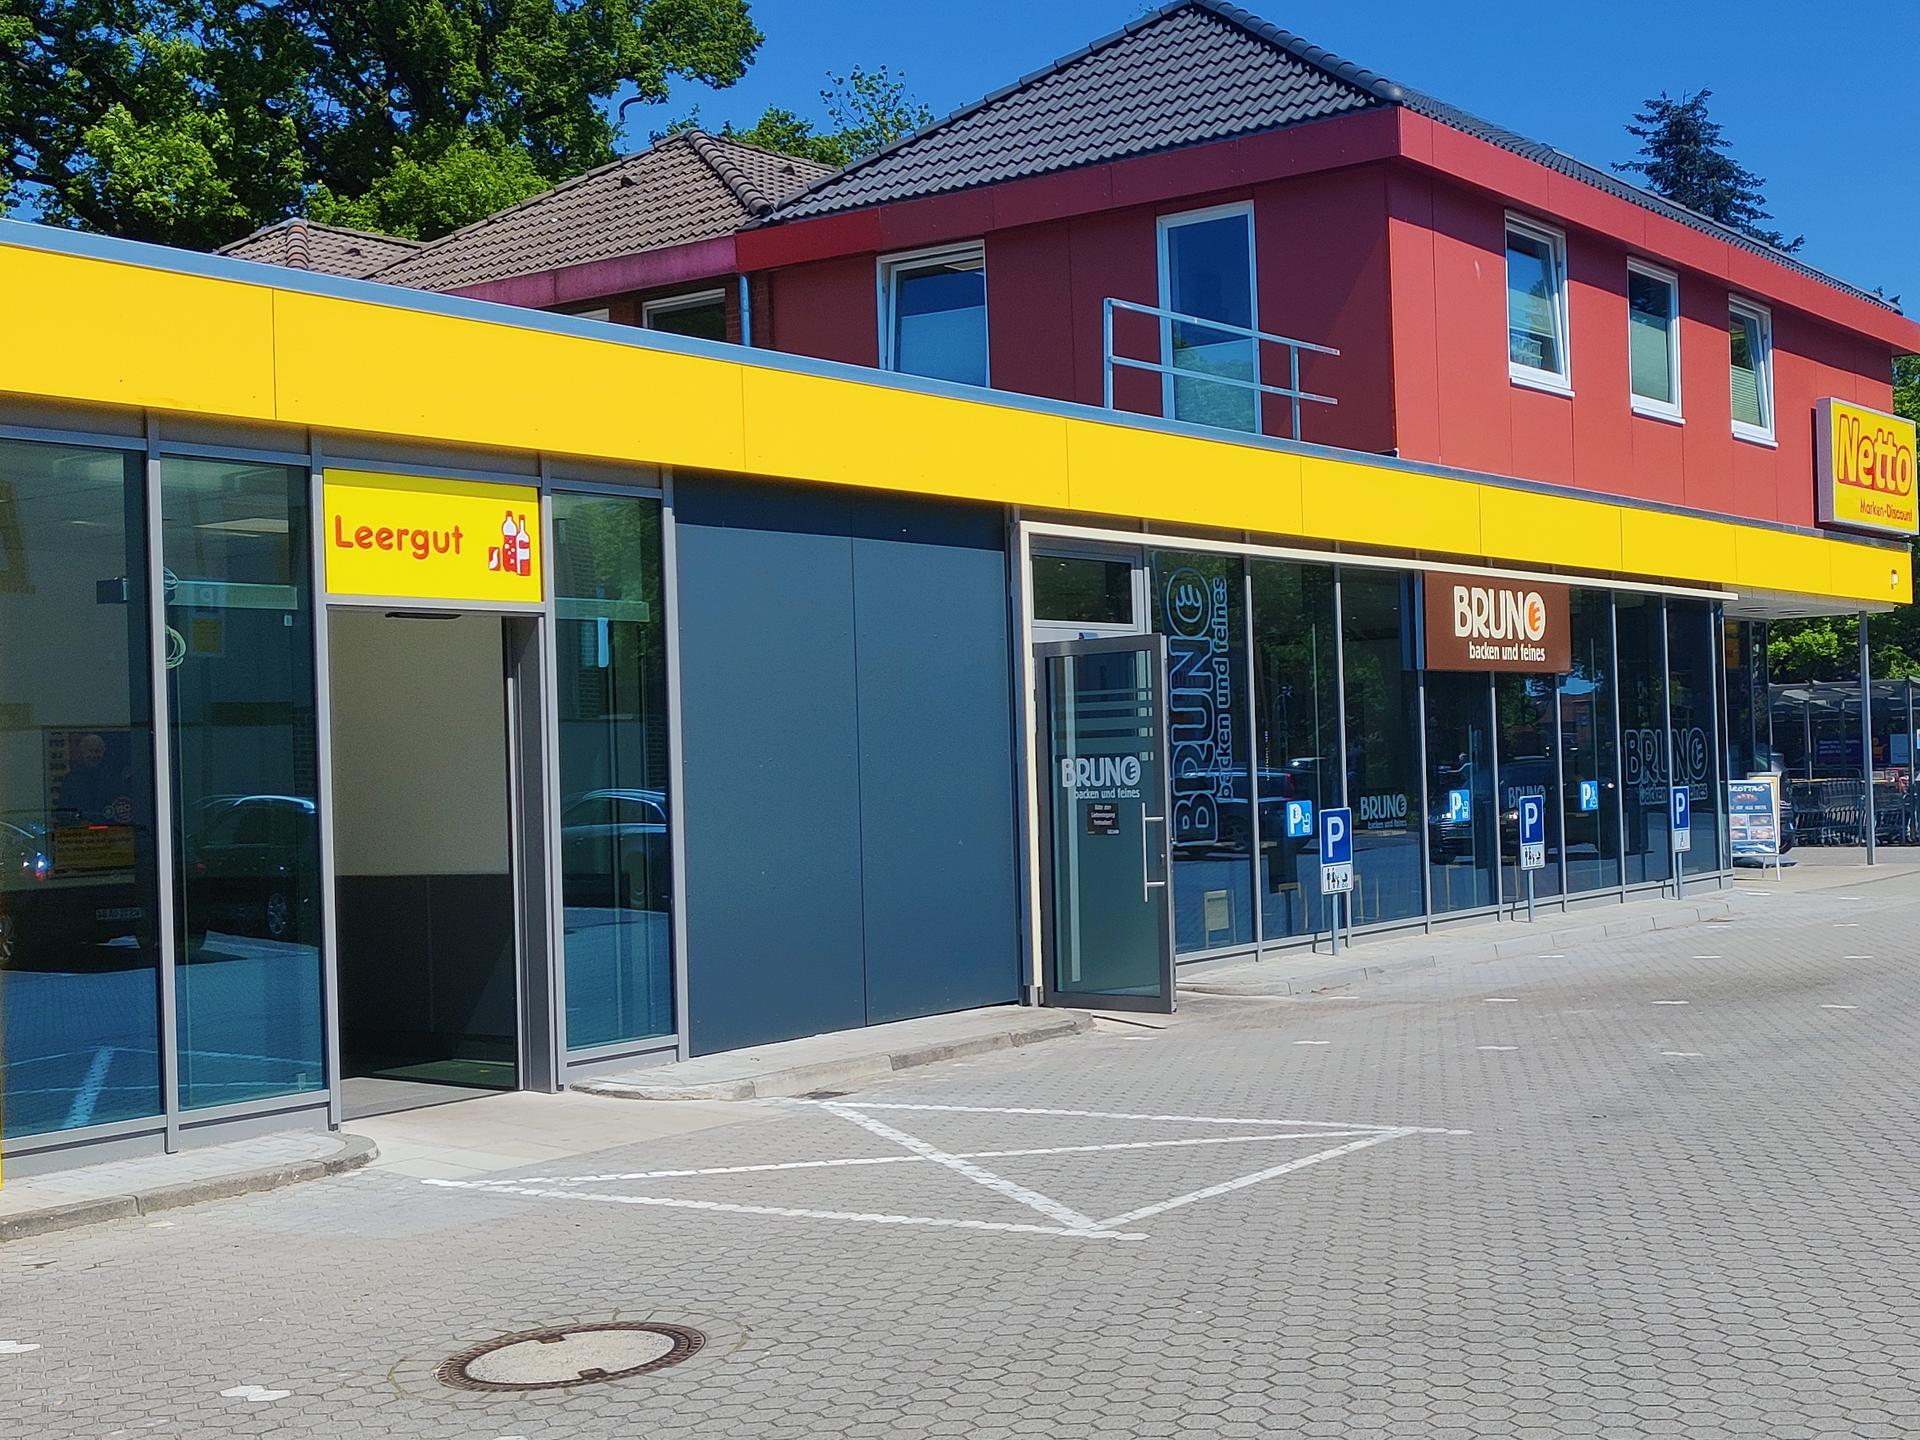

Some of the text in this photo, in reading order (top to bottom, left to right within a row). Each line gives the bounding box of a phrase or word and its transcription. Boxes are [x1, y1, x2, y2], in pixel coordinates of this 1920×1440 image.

[1837, 413, 1912, 496] Netto
[1860, 499, 1912, 522] Marken-Discount
[335, 515, 463, 560] Leergut
[1453, 585, 1546, 641] BRUNO
[1469, 641, 1546, 661] backen und feines
[1212, 576, 1233, 803] backen und feines
[1166, 567, 1218, 846] BRUNO
[1061, 756, 1141, 788] BRUNO
[1074, 788, 1140, 799] backen und feines
[1360, 793, 1408, 820] BRUNO
[1451, 792, 1462, 820] P
[1583, 783, 1591, 809] P
[1676, 793, 1686, 825] P
[1289, 803, 1302, 834] P
[1524, 802, 1538, 838] P
[1327, 816, 1345, 858] P
